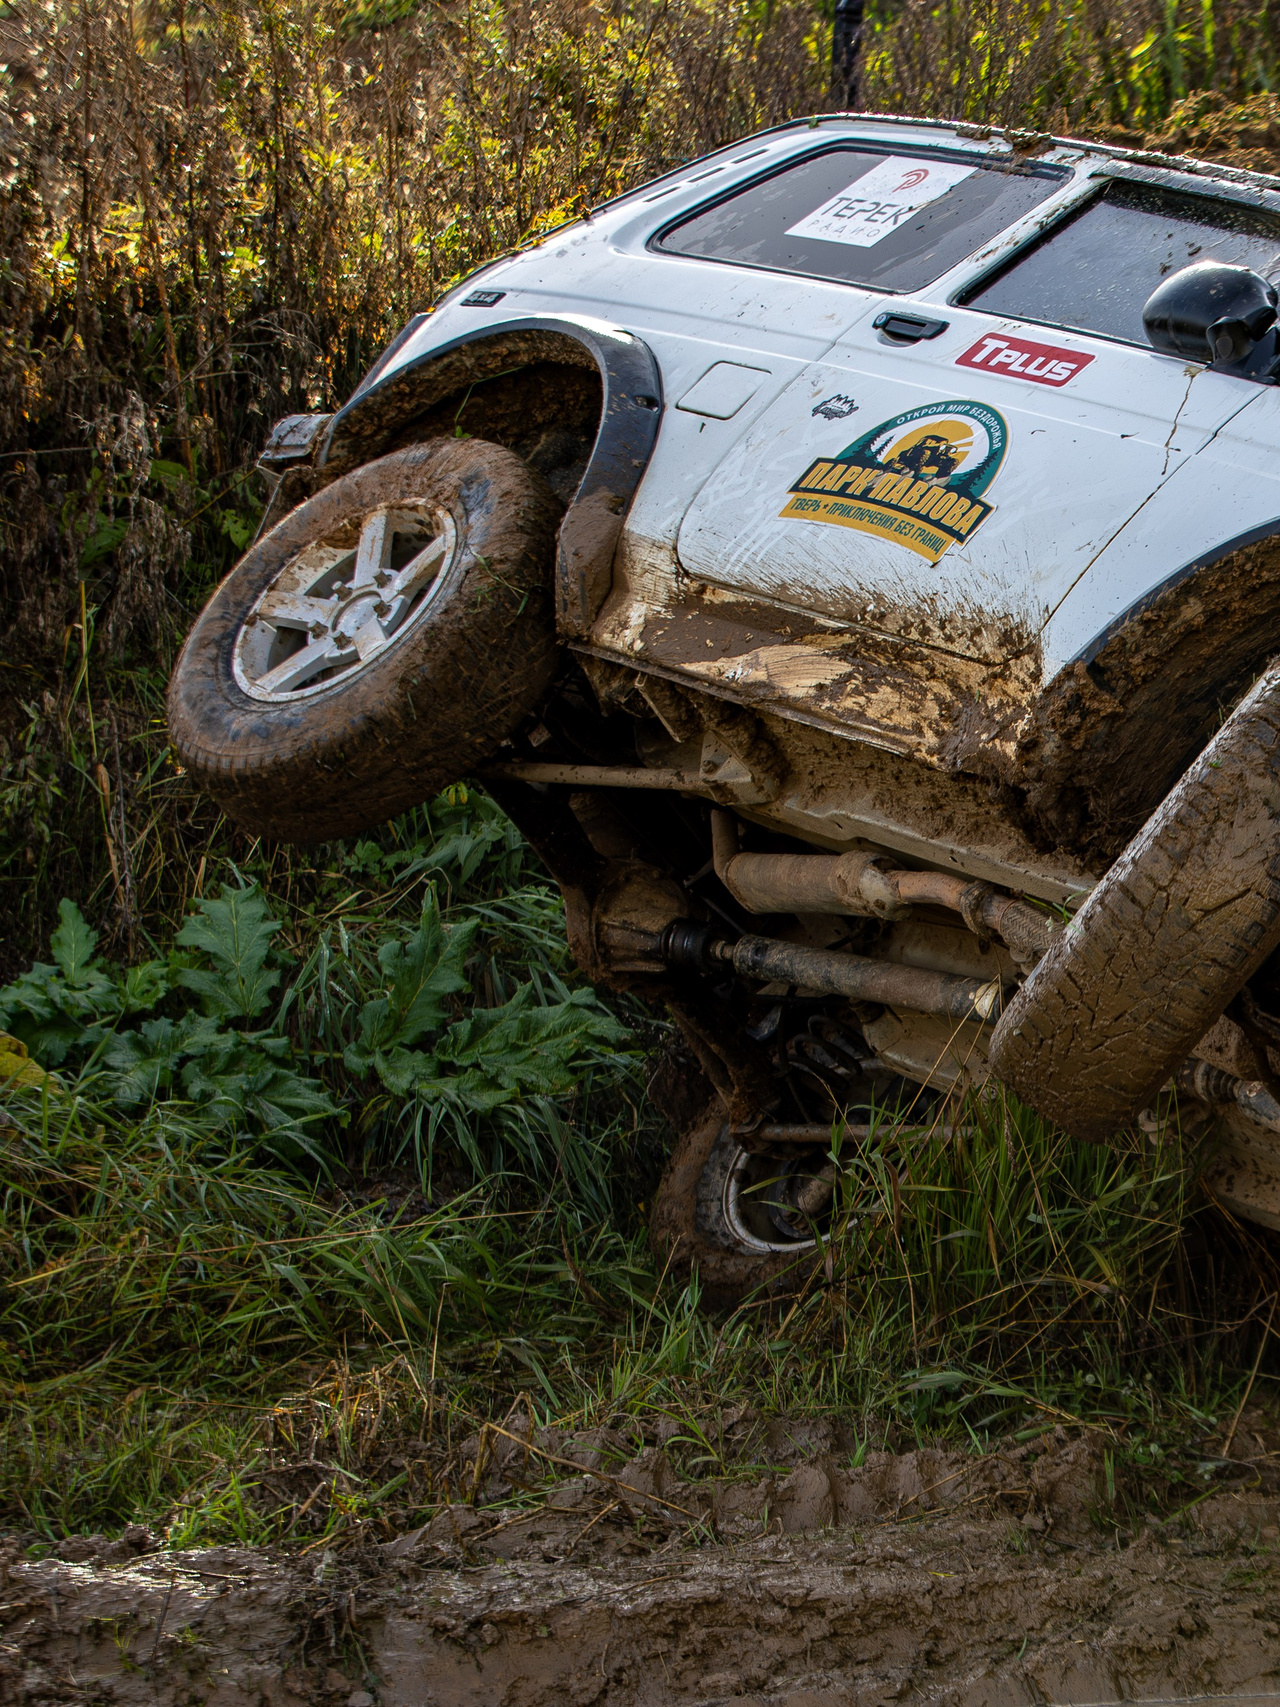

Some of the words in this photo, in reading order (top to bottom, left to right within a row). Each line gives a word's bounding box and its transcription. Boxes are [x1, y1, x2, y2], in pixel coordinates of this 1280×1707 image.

[809, 220, 880, 238] РАДИО
[821, 197, 909, 226] ТЕРЕК
[896, 404, 946, 425] ОТКРОЙ
[946, 404, 970, 413] МИР
[968, 406, 1002, 450] БЕЗДОРОЖЬЯ
[799, 461, 878, 495] ПАРК
[867, 473, 985, 535] ПАВЛОВА
[790, 498, 822, 513] ТВЕРЬ
[826, 502, 899, 529] ПРИКЛЮЧЕНИЯ
[893, 520, 914, 537] БЕЗ
[911, 526, 947, 555] ГРАНИЦ
